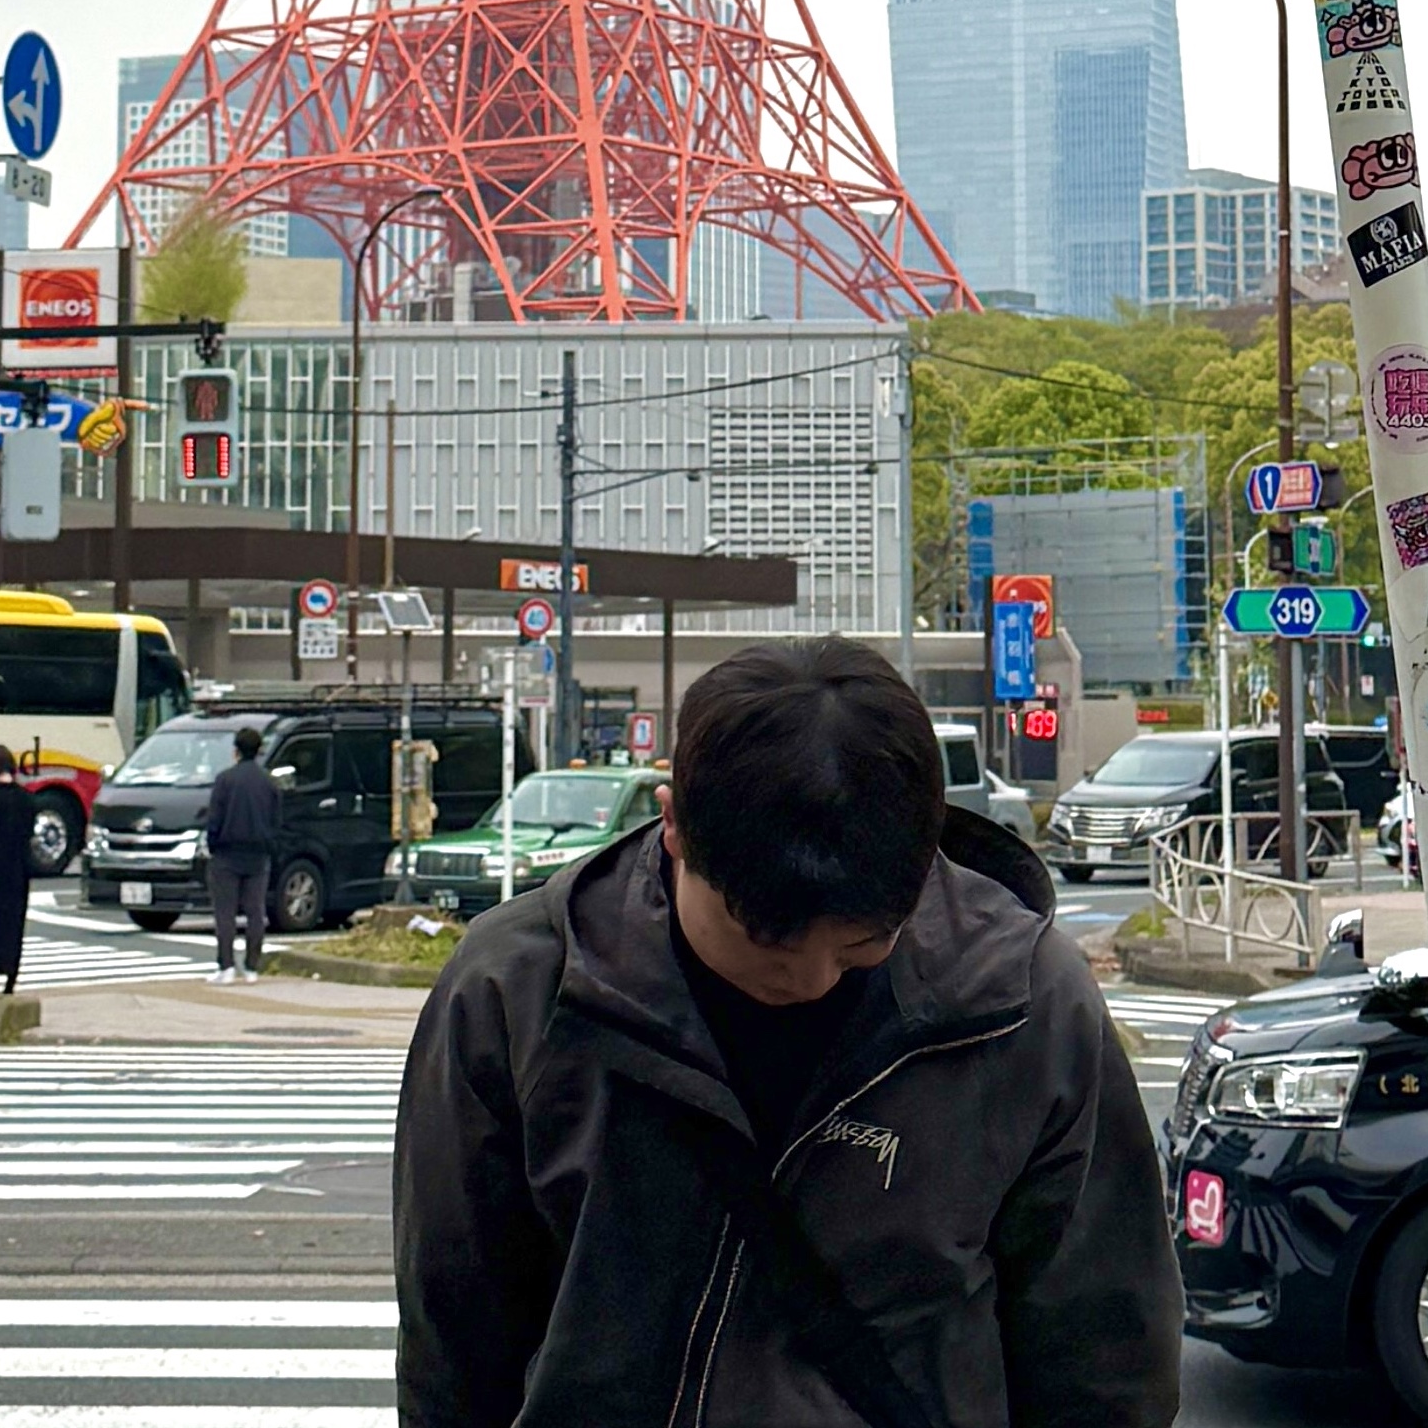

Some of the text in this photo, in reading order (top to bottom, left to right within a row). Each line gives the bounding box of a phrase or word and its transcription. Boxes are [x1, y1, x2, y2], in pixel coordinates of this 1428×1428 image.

[1360, 230, 1423, 274] MAFIA
[25, 299, 93, 318] ENEOS
[1276, 597, 1316, 625] 319
